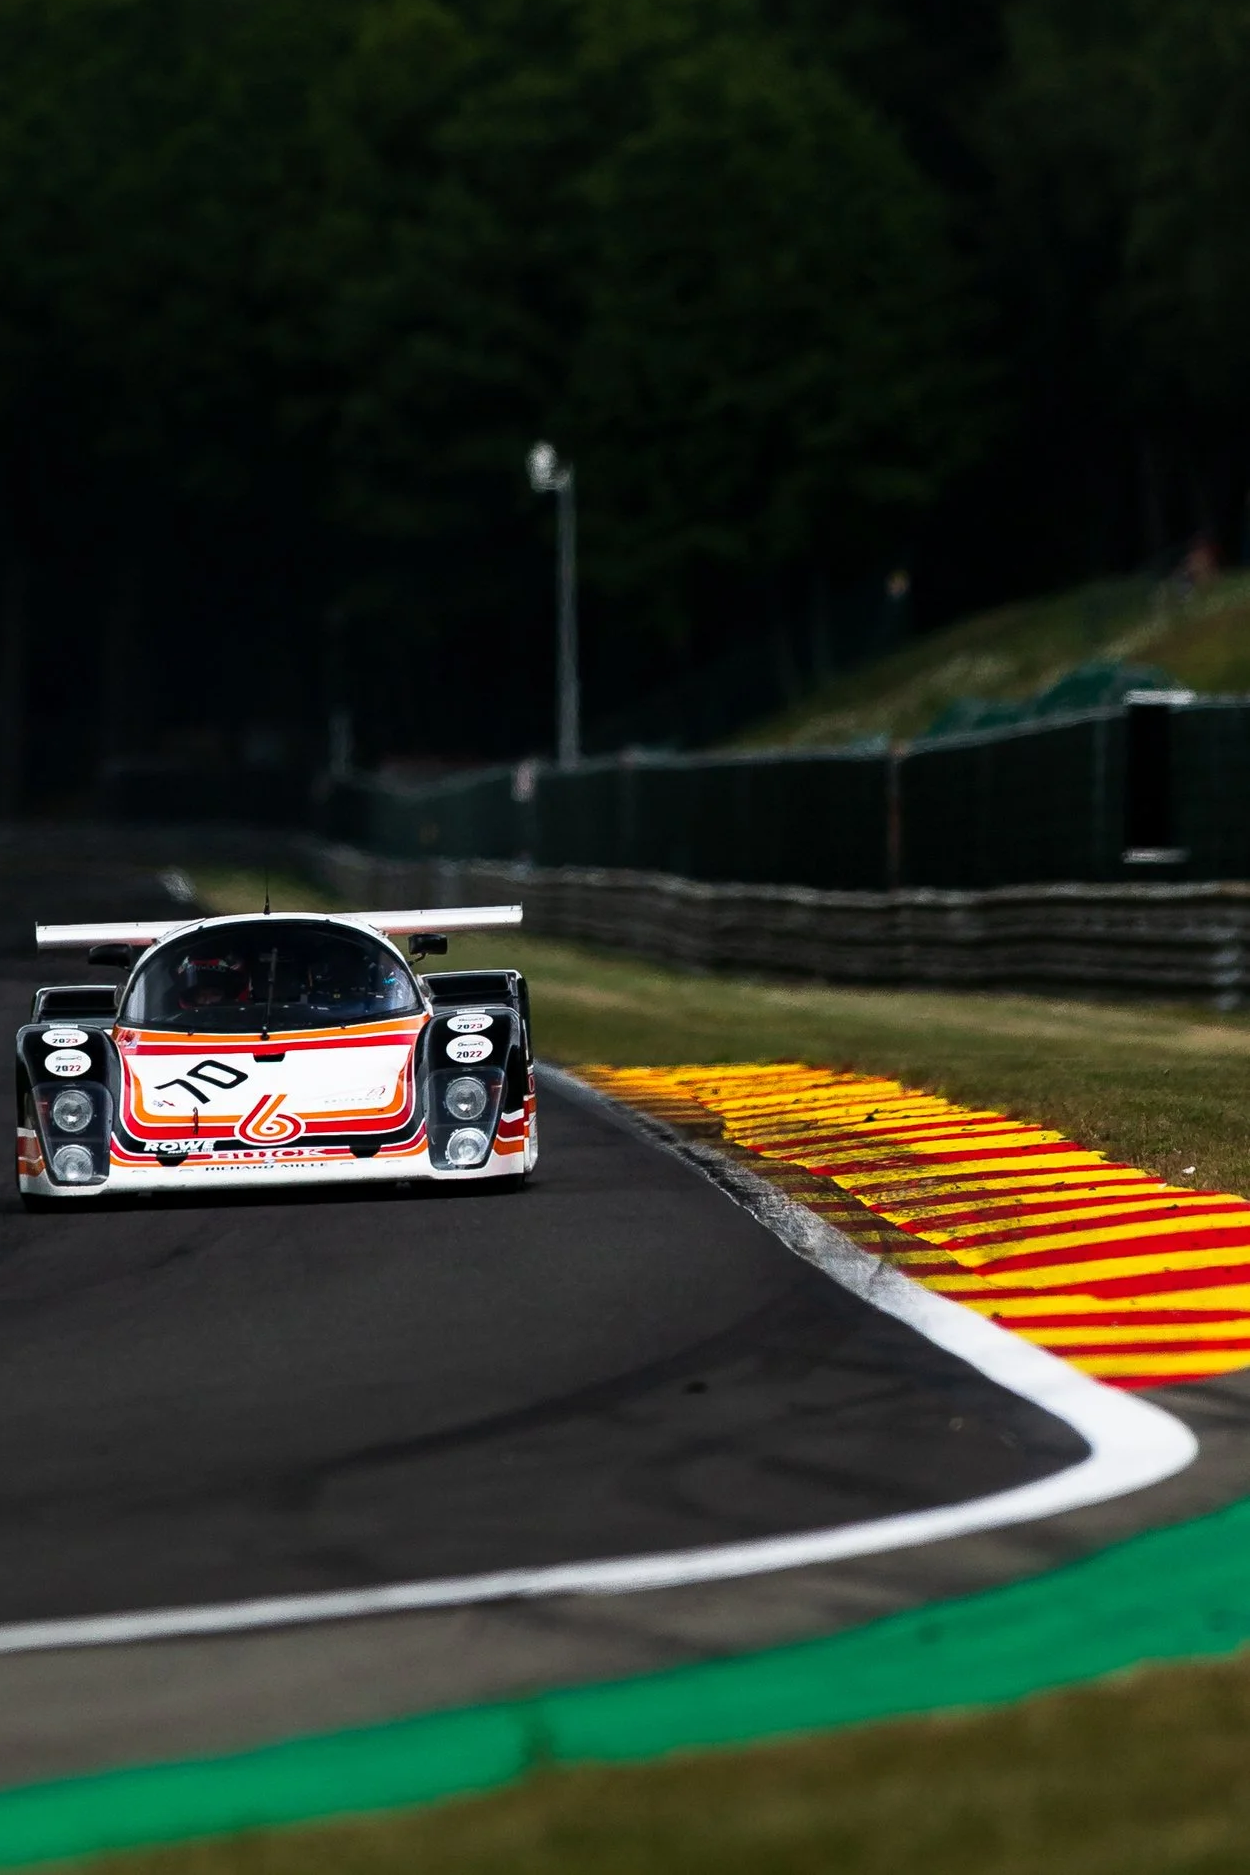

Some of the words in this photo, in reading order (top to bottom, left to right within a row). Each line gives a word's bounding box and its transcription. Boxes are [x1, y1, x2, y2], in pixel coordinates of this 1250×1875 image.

[456, 1050, 483, 1059] 2022
[154, 1059, 249, 1104] 70
[144, 1140, 215, 1152] ROWE
